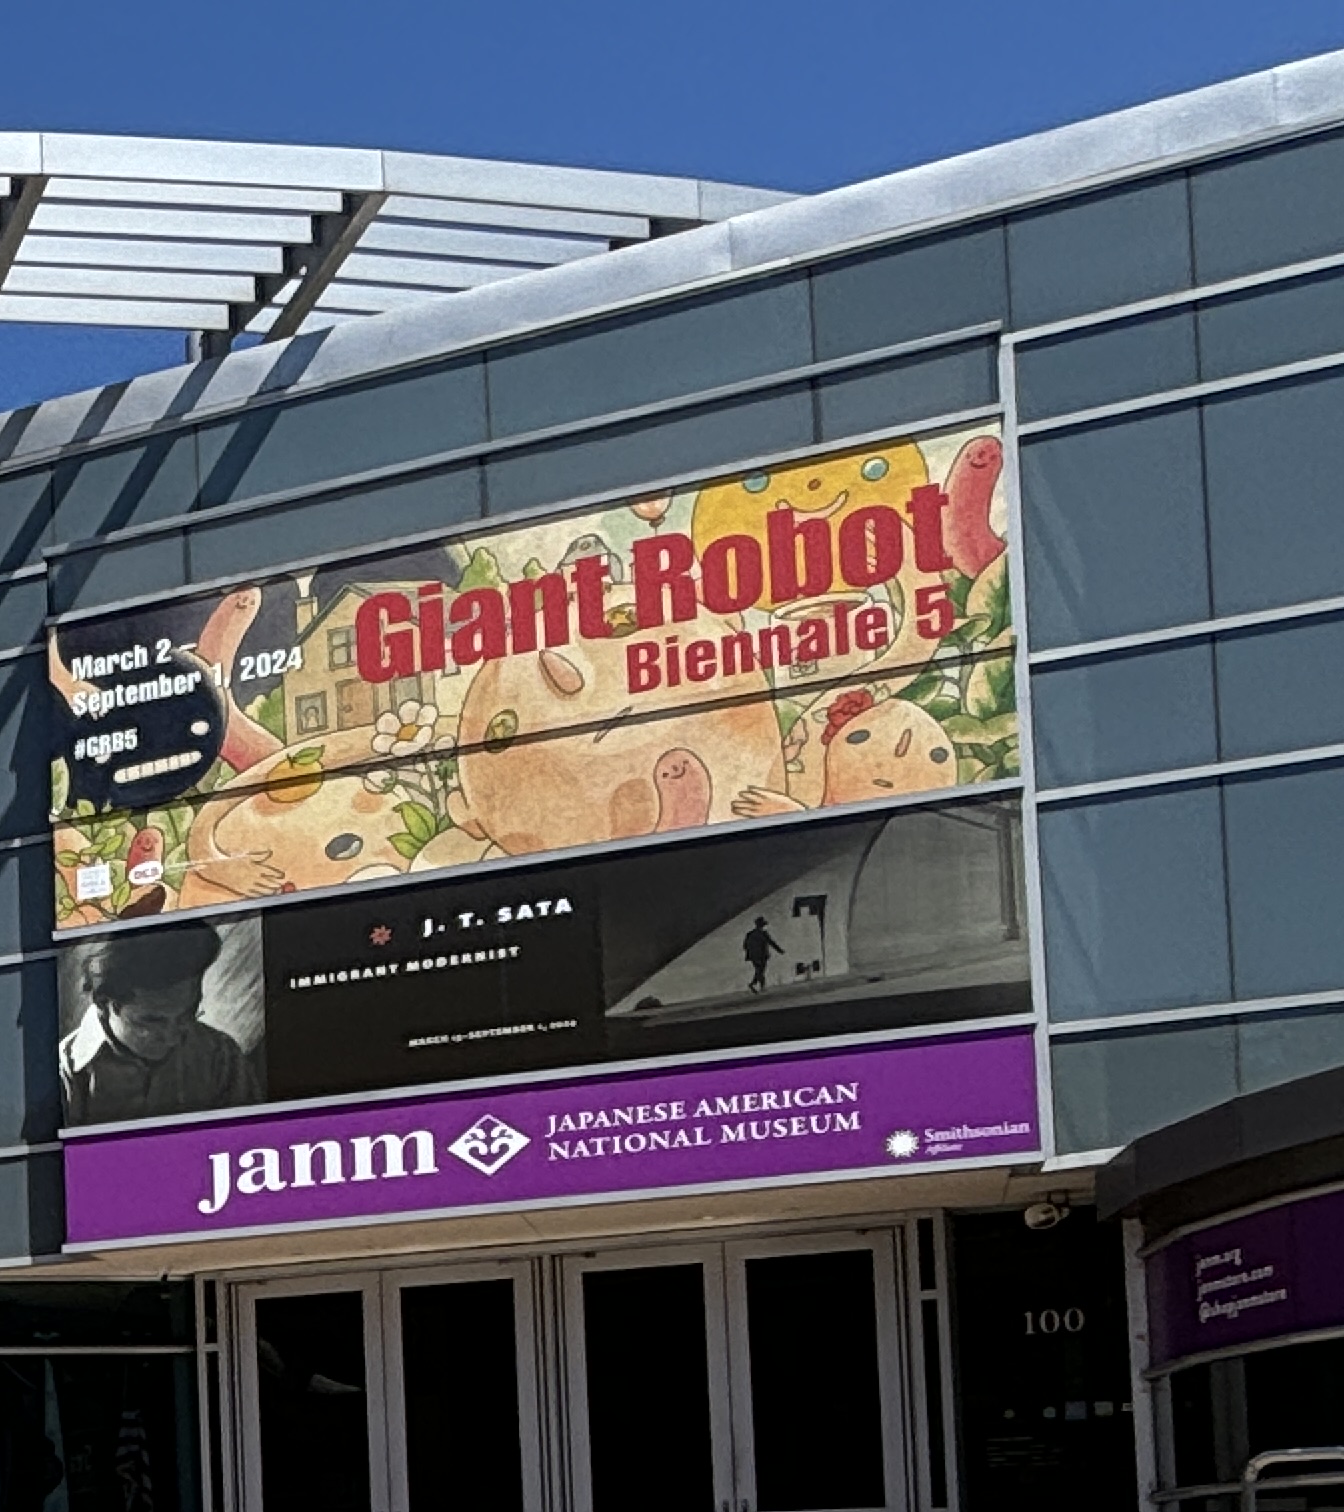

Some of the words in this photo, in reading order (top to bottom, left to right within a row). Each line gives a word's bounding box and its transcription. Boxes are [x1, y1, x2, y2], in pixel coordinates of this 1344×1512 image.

[355, 552, 613, 684] Giant
[632, 482, 954, 629] Robot
[71, 644, 148, 682] March
[155, 638, 172, 664] 2
[625, 600, 888, 694] Biennale
[915, 585, 955, 640] 5
[71, 670, 202, 720] September
[212, 663, 231, 689] 1,
[240, 645, 302, 682] 2024
[74, 727, 138, 761] #GRB5
[422, 918, 446, 938] J.
[459, 912, 485, 928] T.
[497, 897, 573, 923] SATA
[290, 963, 400, 989] IMMIGRANT
[405, 945, 521, 972] MODERNIST
[545, 1099, 687, 1138] JAPANESE
[693, 1082, 860, 1118] AMERICAN
[924, 1121, 1030, 1143] Smithsonian
[547, 1127, 712, 1162] NATIONAL
[720, 1110, 861, 1143] MUSEUM
[198, 1129, 440, 1214] janm
[1024, 1307, 1086, 1335] 100
